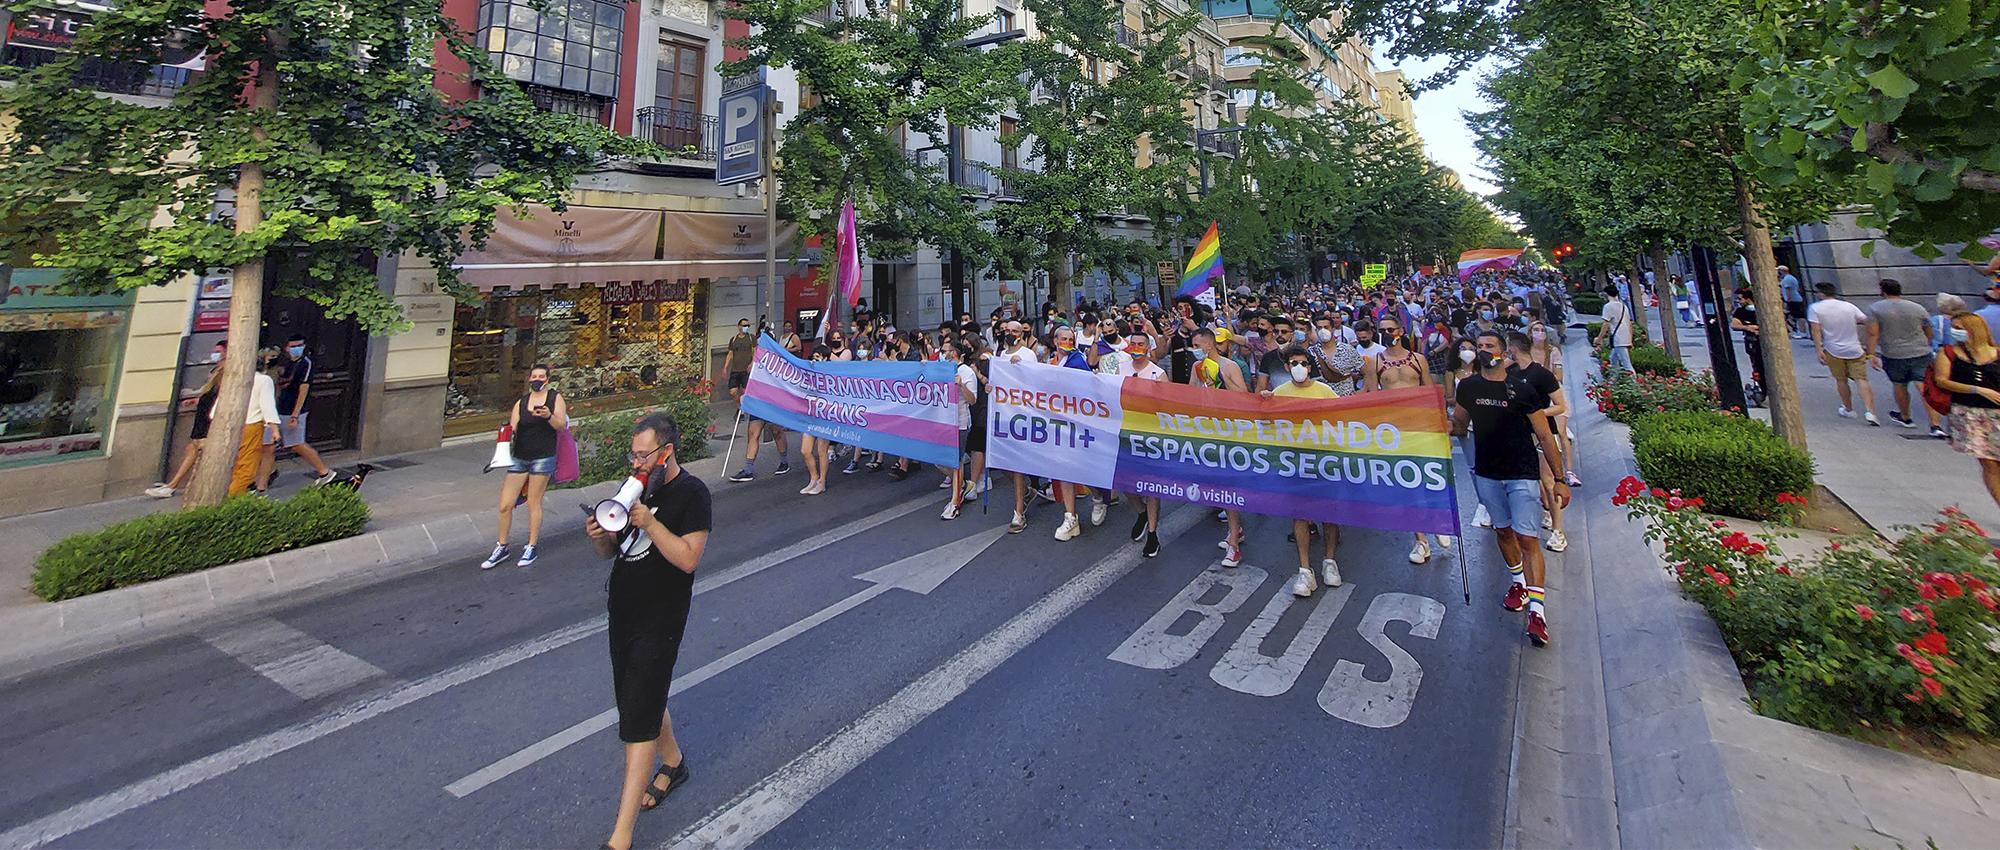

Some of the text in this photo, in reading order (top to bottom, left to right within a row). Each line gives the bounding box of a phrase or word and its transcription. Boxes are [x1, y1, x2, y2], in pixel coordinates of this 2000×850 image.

[725, 96, 758, 145] P
[554, 229, 581, 237] Minelli
[758, 351, 950, 408] AUTODETERMINACIÓN
[805, 394, 868, 428] TRANS
[995, 386, 1110, 418] DERECHOS
[1475, 398, 1508, 408] ORGULLO
[994, 411, 1095, 449] LGBTI+
[1156, 411, 1401, 450] RECUPERANDO
[1129, 434, 1447, 491] ESPACIOS SEGUROS
[1136, 480, 1245, 506] granada visible
[1106, 560, 1446, 728] BUS
